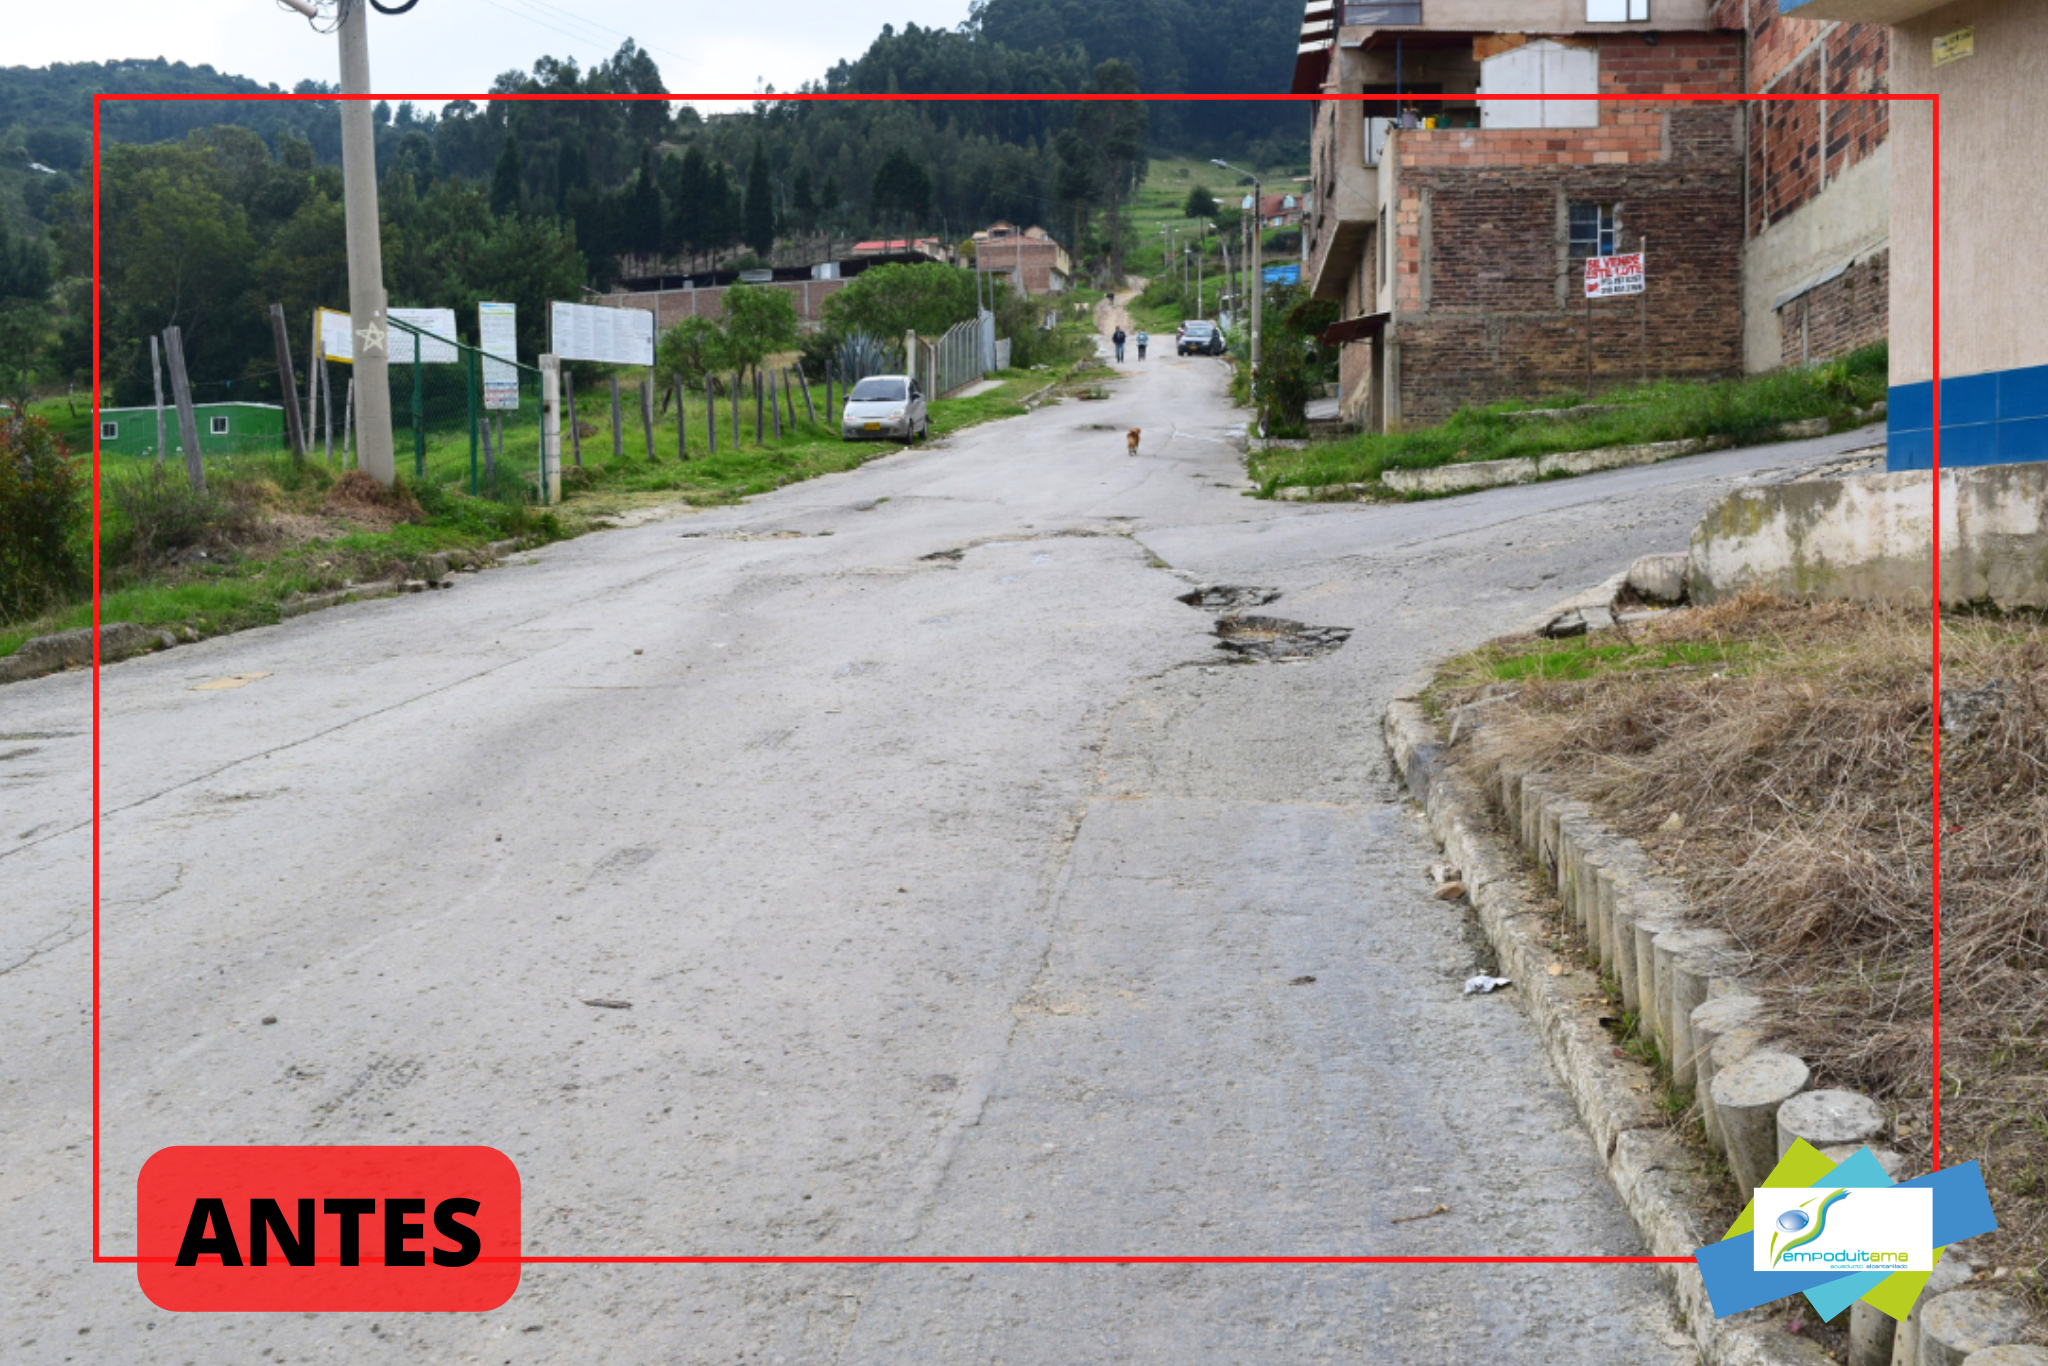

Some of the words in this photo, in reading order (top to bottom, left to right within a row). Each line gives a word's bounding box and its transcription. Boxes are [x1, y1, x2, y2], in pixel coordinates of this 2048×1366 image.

[1587, 259, 1600, 269] SE
[1603, 254, 1640, 268] VENDE
[1586, 268, 1613, 279] ESTE
[1616, 264, 1643, 275] LOTE
